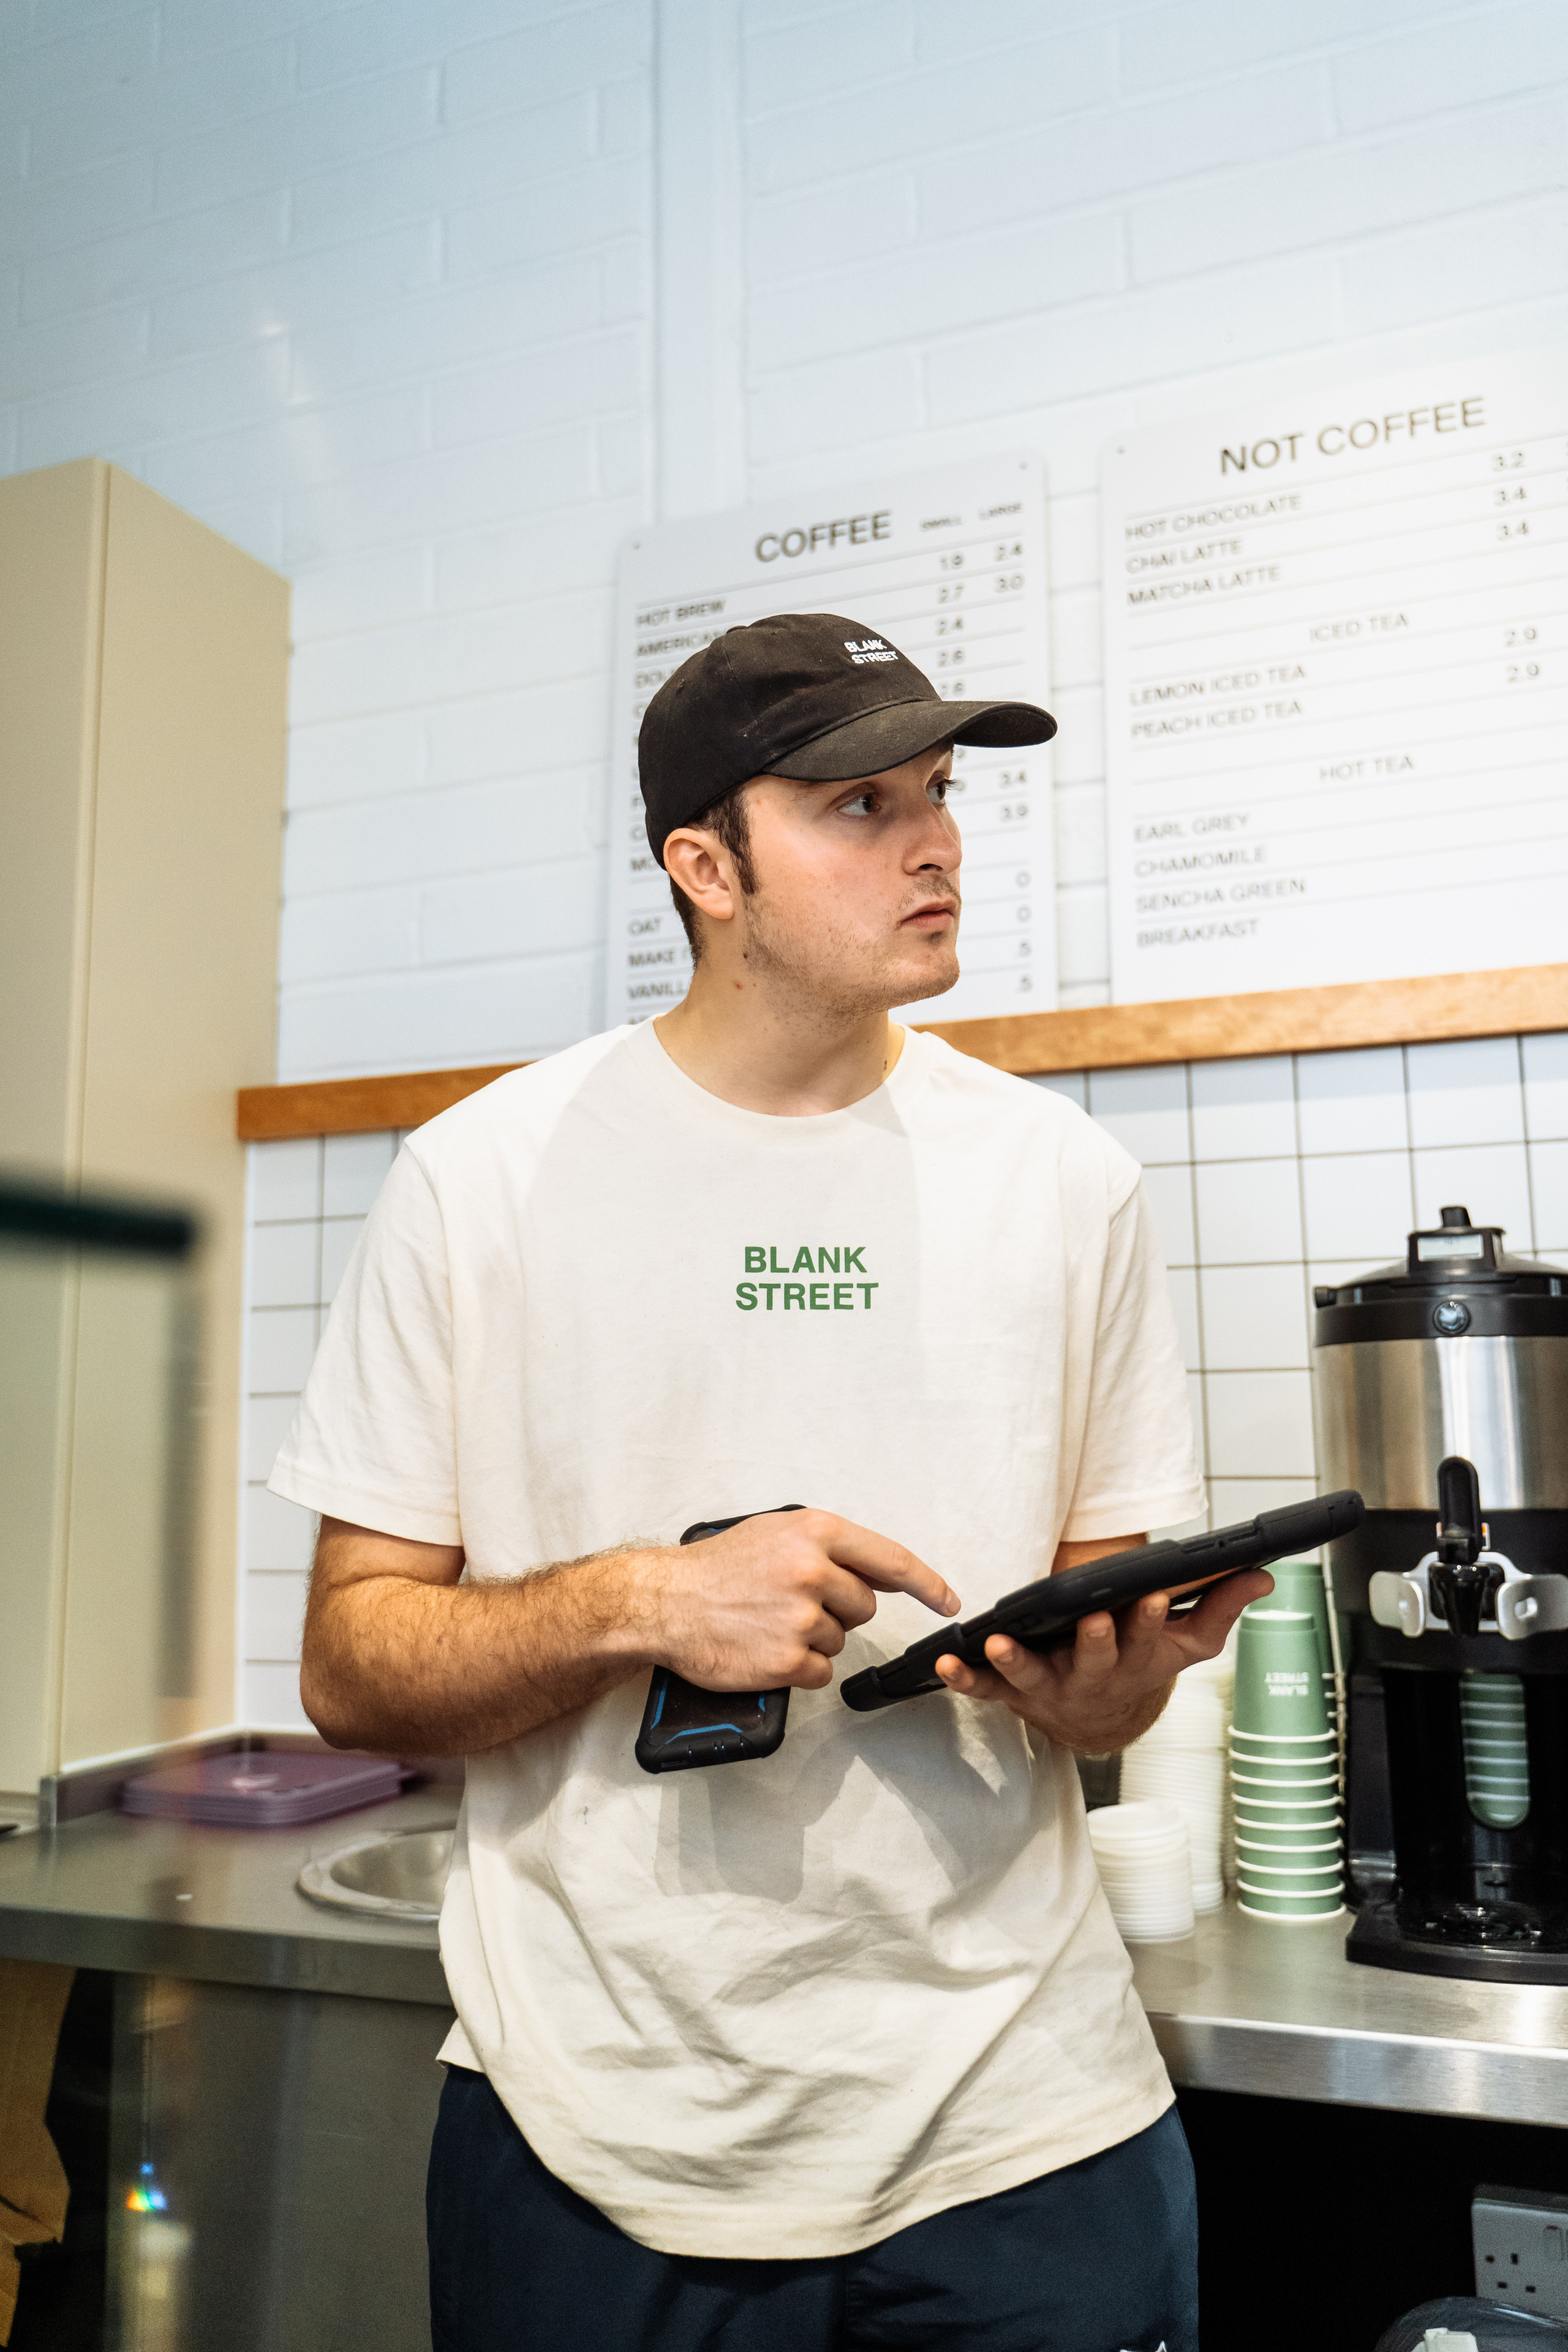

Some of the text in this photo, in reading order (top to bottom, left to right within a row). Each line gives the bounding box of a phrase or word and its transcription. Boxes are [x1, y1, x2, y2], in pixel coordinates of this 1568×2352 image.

[1220, 396, 1485, 476] NOT COFFEE
[1125, 449, 1526, 541] HOT CHOCOLATE 3.2
[755, 510, 892, 563] COFFEE
[1126, 485, 1527, 574] CHAI LATTE 3.4
[1127, 518, 1529, 605] MATCHA LATTE 3.4
[636, 608, 670, 628] HOT
[676, 597, 727, 622] BREW
[1310, 612, 1408, 643] ICED TEA
[844, 639, 888, 653] BLANK
[851, 650, 899, 664] STREET
[1129, 625, 1538, 707] LEMON ICED TEA 2.9
[1131, 662, 1541, 739] PEACH ICED TEA 2.9
[1320, 755, 1414, 782] HOT TEA
[1133, 812, 1251, 844] EARL GREY
[1135, 845, 1267, 878] CHAMOMILE
[1136, 878, 1306, 913] SENCHA GREEN
[628, 917, 662, 937] OAT
[1137, 918, 1259, 949] BREAKFAST
[628, 947, 675, 967] MAKE
[627, 979, 690, 1000] VANILL
[744, 1246, 868, 1273] BLANK
[735, 1282, 879, 1311] STREET
[1264, 1672, 1309, 1684] STREET
